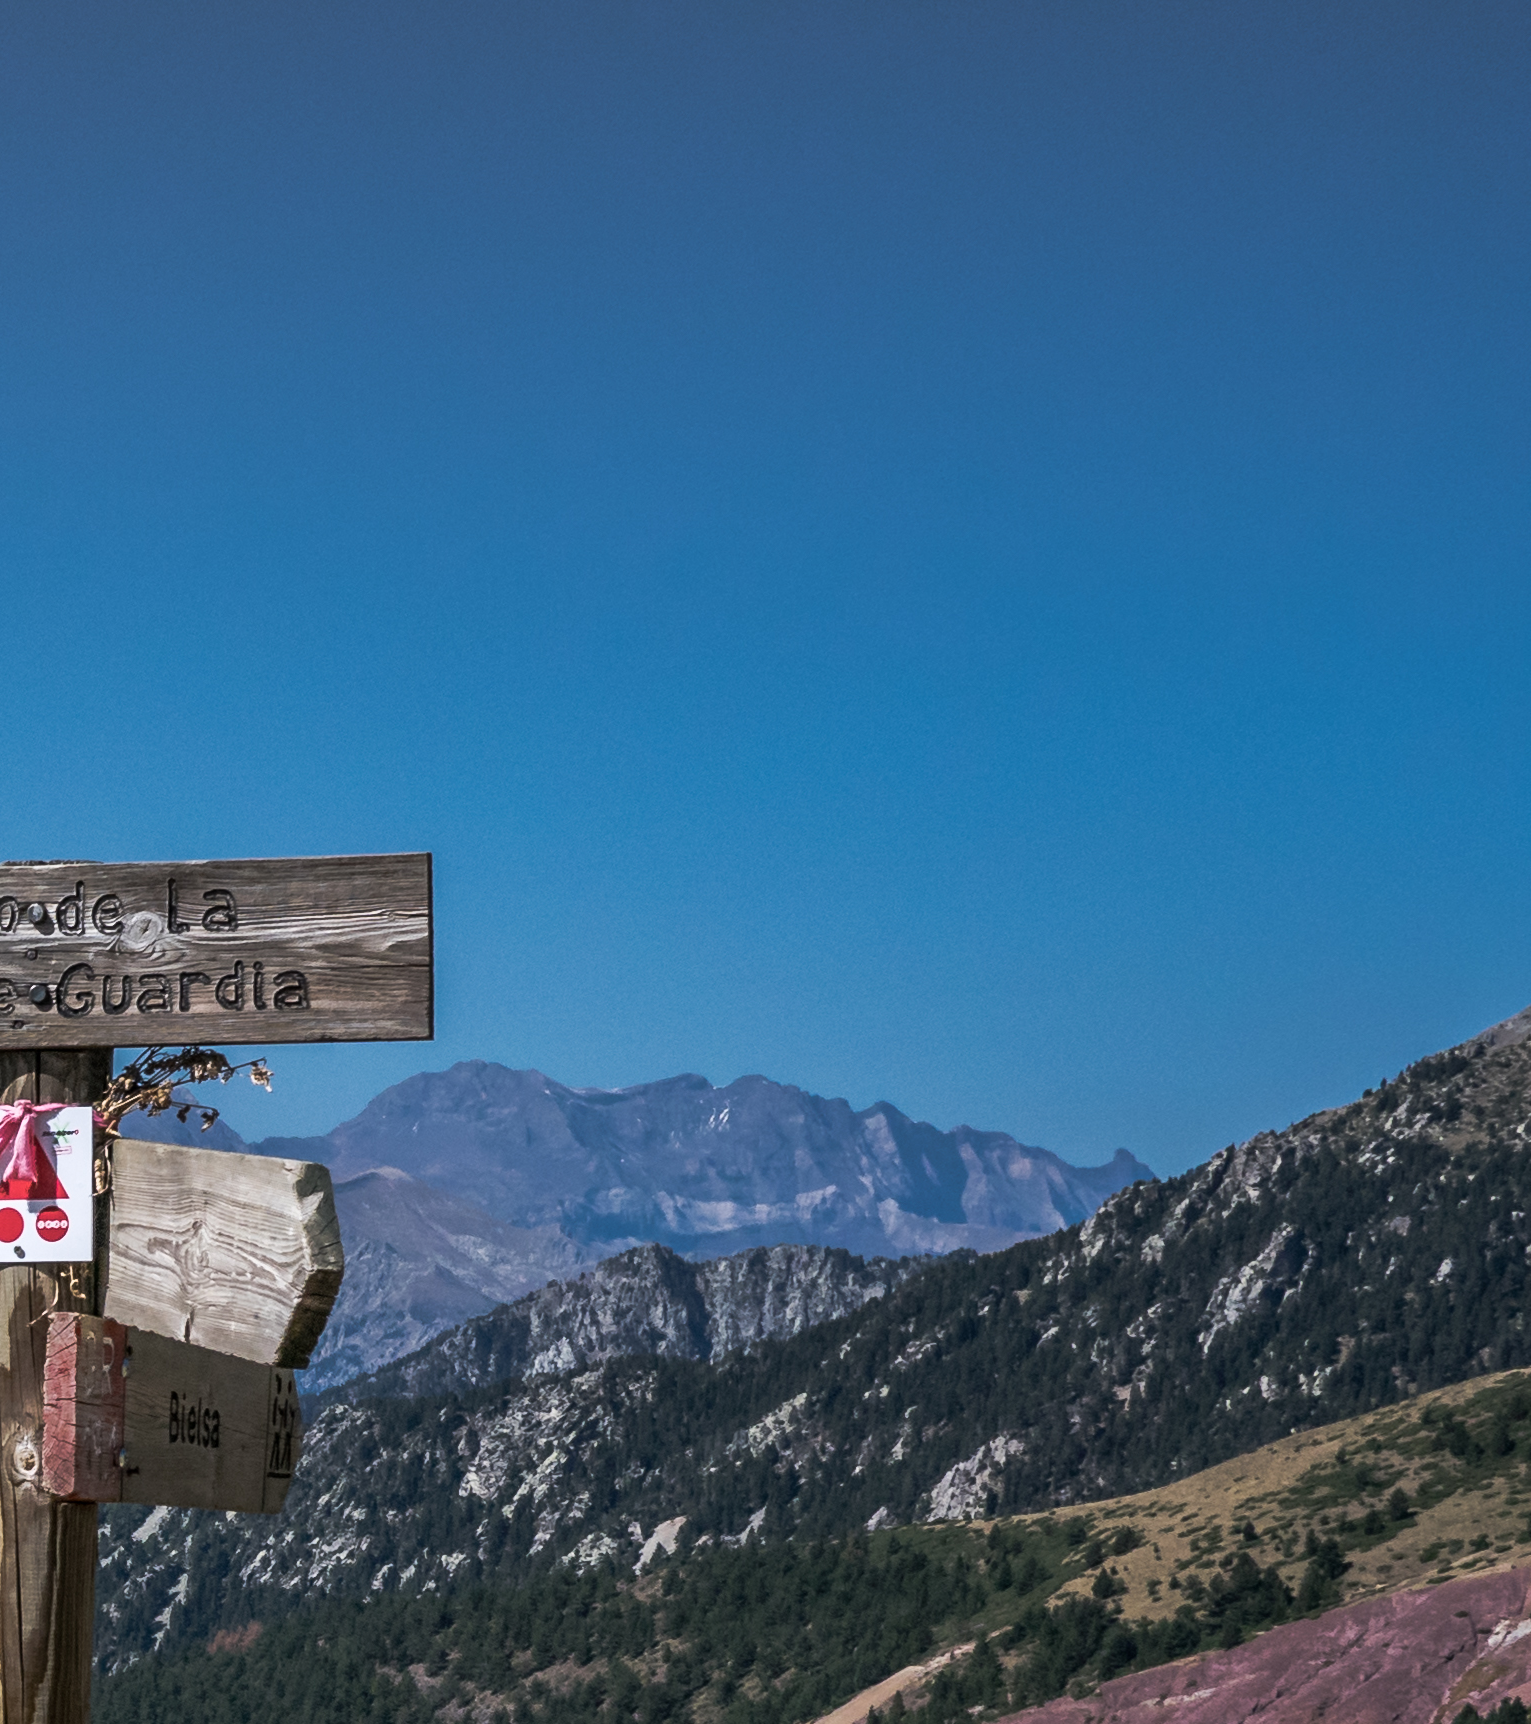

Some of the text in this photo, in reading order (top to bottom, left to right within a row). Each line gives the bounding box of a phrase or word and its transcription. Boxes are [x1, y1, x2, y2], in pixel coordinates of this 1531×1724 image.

[56, 879, 124, 936] de
[166, 877, 237, 933] La
[56, 959, 310, 1018] Guardia
[168, 1390, 221, 1448] Bielsa
